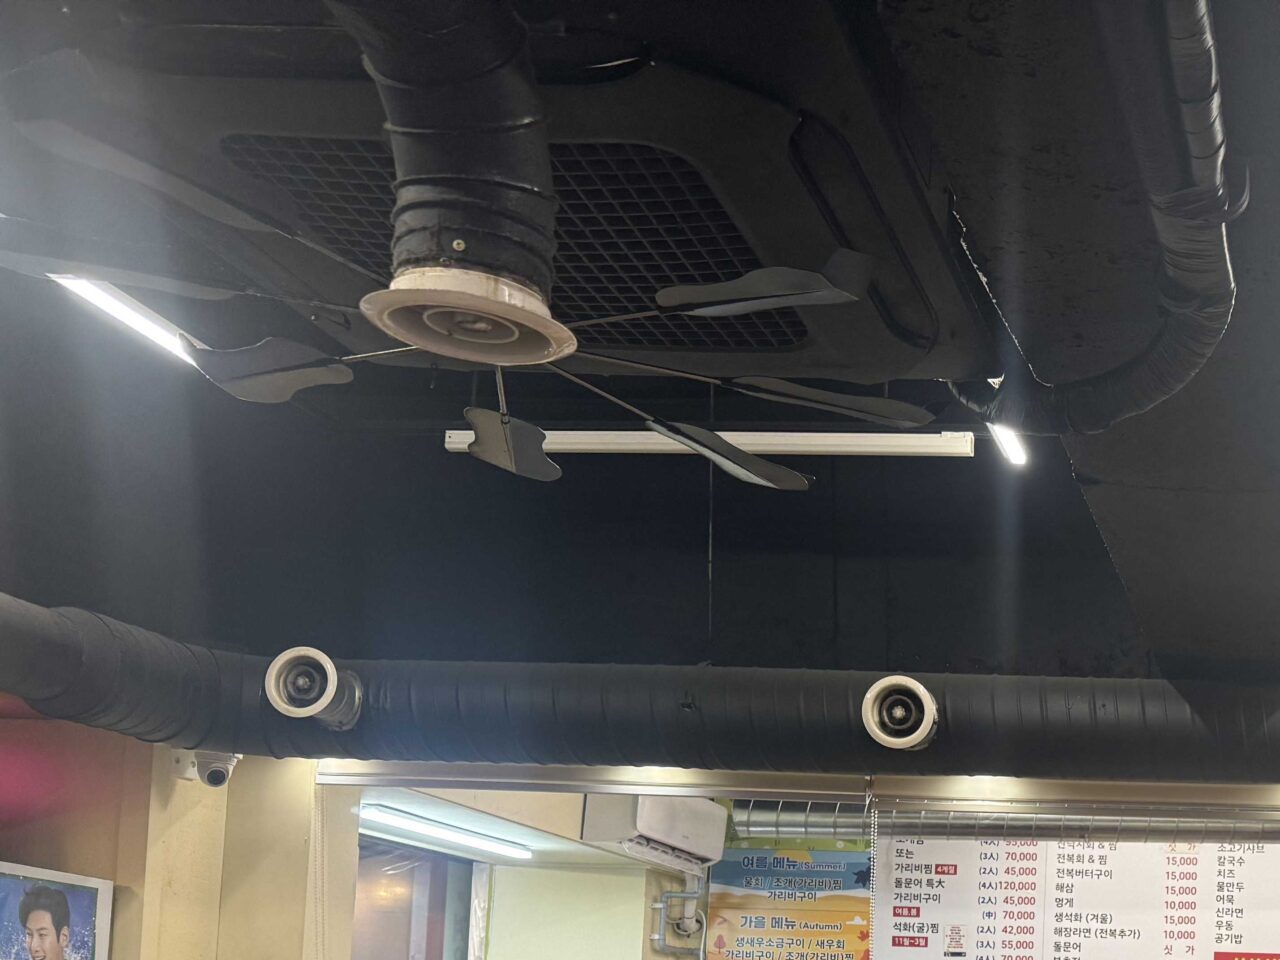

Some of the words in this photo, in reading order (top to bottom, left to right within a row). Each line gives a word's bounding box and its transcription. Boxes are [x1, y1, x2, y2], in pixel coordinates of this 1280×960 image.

[896, 848, 914, 859] 또는
[1005, 853, 1037, 863] 70,000
[1057, 855, 1084, 864] 전복회
[1099, 855, 1107, 865] 찜
[1166, 857, 1197, 867] 15,000
[742, 856, 767, 869] 여름
[772, 857, 798, 869] 메뉴
[801, 862, 846, 870] (Summer)
[1217, 856, 1245, 867] 칼국수
[895, 863, 933, 874] 가리비찜
[1004, 867, 1037, 877] 45,000
[1056, 869, 1113, 880] 전복버터구이
[1217, 869, 1235, 879] 치즈
[894, 878, 922, 888] 돌문어
[999, 881, 1036, 892] 120,000
[1055, 883, 1073, 894] 해삼
[1217, 882, 1244, 892] 물만두
[768, 892, 817, 901] 가리비구이
[894, 893, 940, 904] 가리비구이
[1216, 895, 1234, 905] 어묵
[1055, 898, 1073, 908] 멍게
[1165, 901, 1196, 911] 10,000
[1055, 913, 1081, 923] 생석화
[1086, 913, 1112, 925] (겨울)
[1216, 908, 1244, 919] 신라면
[740, 916, 765, 928] 가을
[771, 917, 796, 930] 메뉴
[799, 922, 842, 931] (Autumn)
[1216, 921, 1233, 930] 우동
[893, 923, 939, 934] 석화(굴)찜
[1002, 926, 1034, 936] 42,000
[1054, 928, 1091, 938] 해장라면
[1095, 929, 1140, 940] (전복추가)
[736, 937, 805, 948] 생새우소금구이
[816, 939, 844, 949] 새우회
[1215, 934, 1242, 944] 공기밥
[1001, 941, 1034, 951] 55,000
[1053, 942, 1081, 952] 돌문어
[725, 950, 774, 960] 가리비구이
